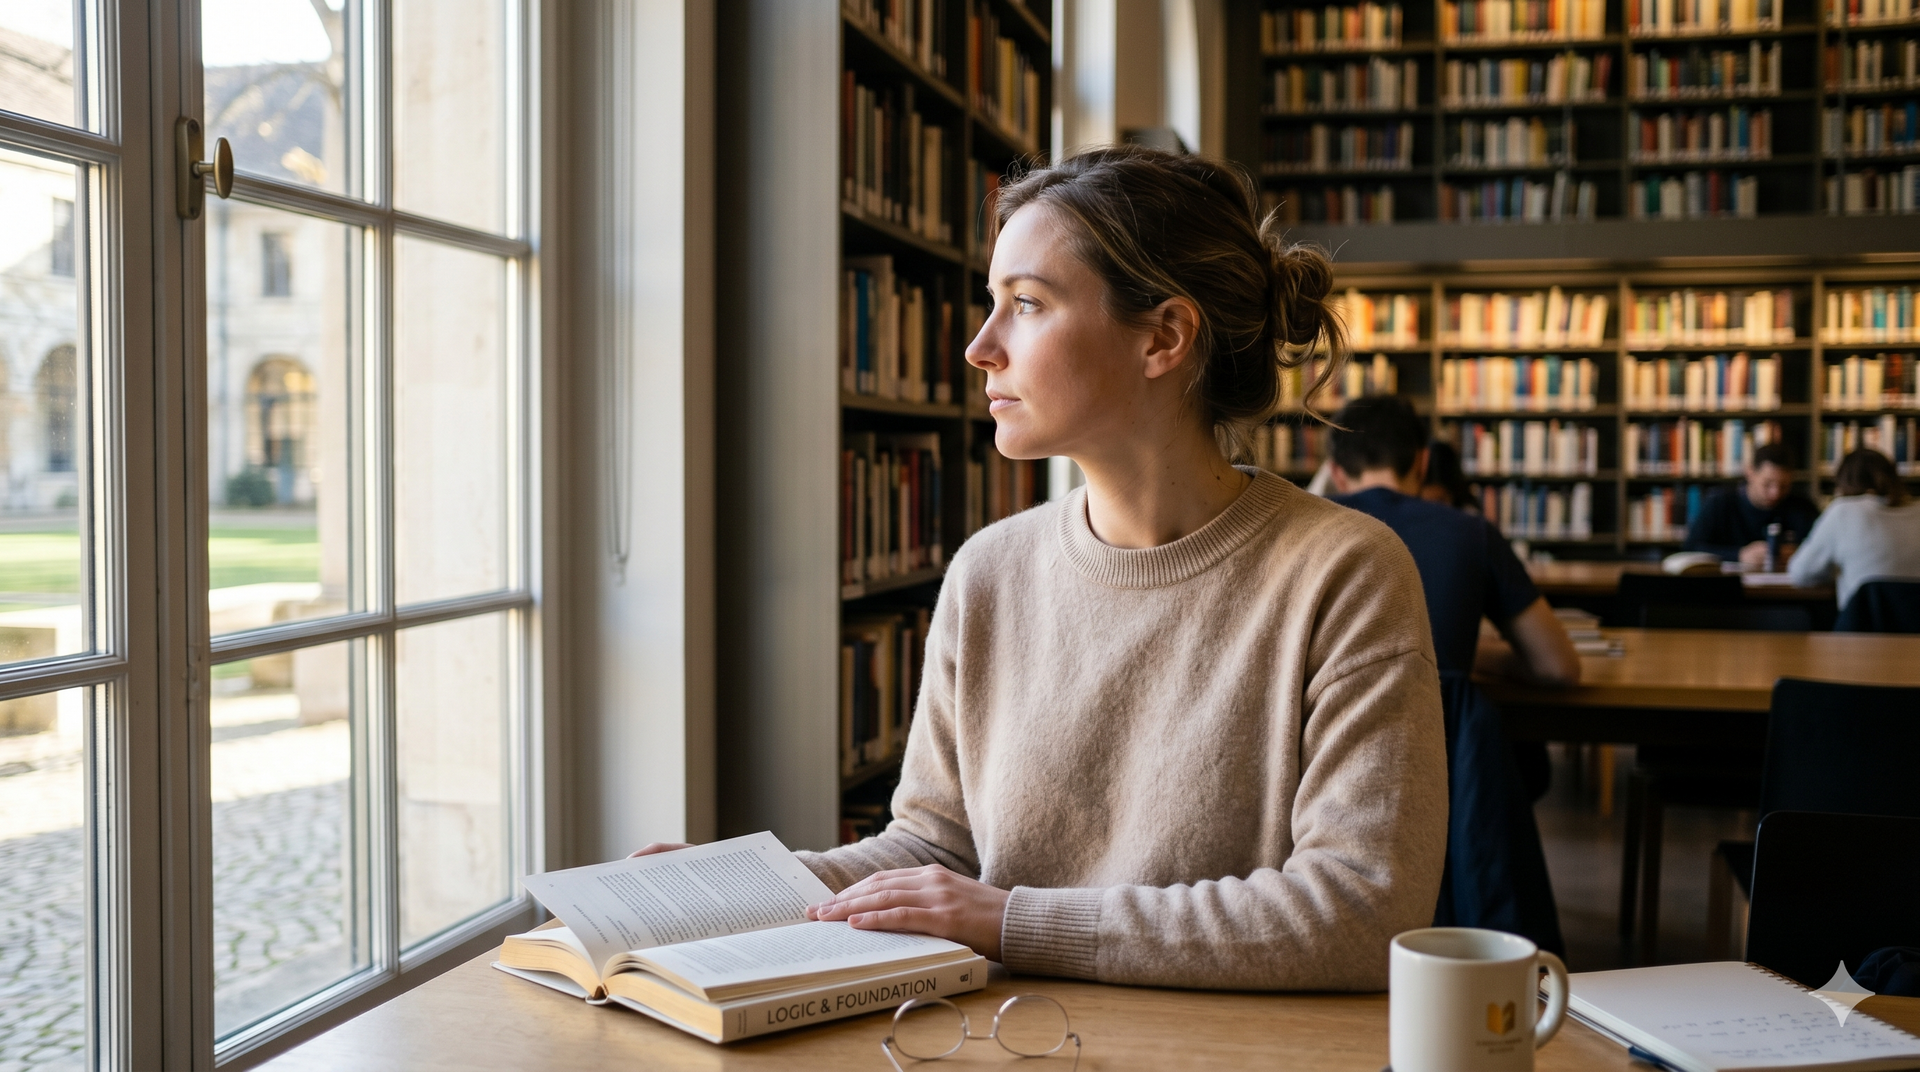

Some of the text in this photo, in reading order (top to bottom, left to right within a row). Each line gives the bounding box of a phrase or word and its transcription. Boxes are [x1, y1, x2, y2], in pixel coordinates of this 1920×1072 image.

[767, 1001, 816, 1024] LOGIC
[820, 998, 831, 1013] &
[836, 977, 937, 1011] FOUNDATION
